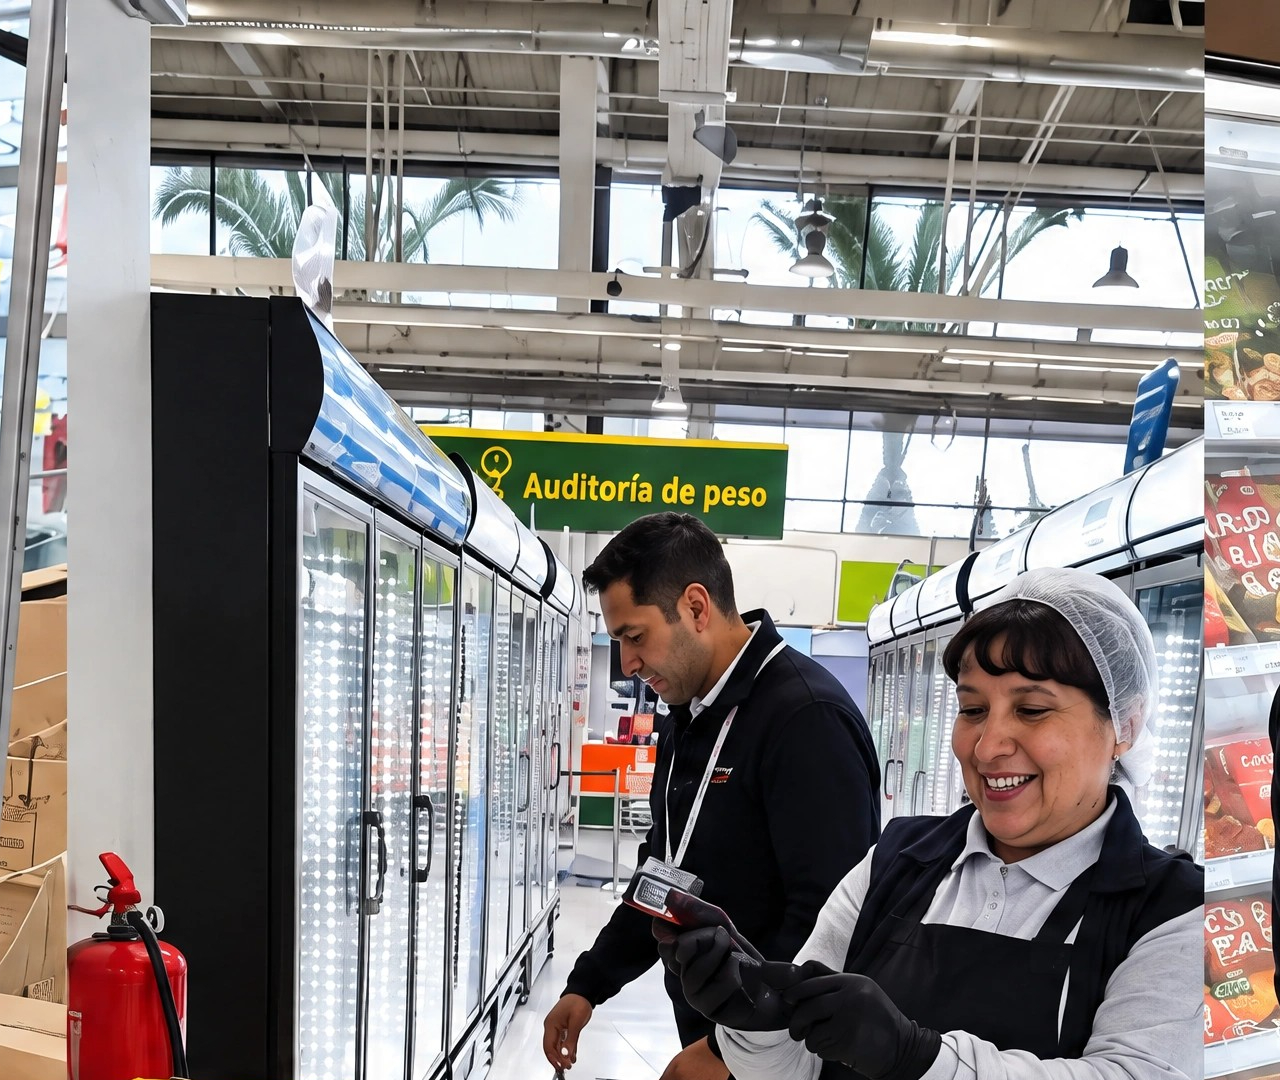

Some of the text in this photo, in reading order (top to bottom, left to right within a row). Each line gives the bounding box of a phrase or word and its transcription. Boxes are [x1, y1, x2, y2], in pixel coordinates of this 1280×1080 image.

[523, 472, 767, 513] Auditoría de peso
